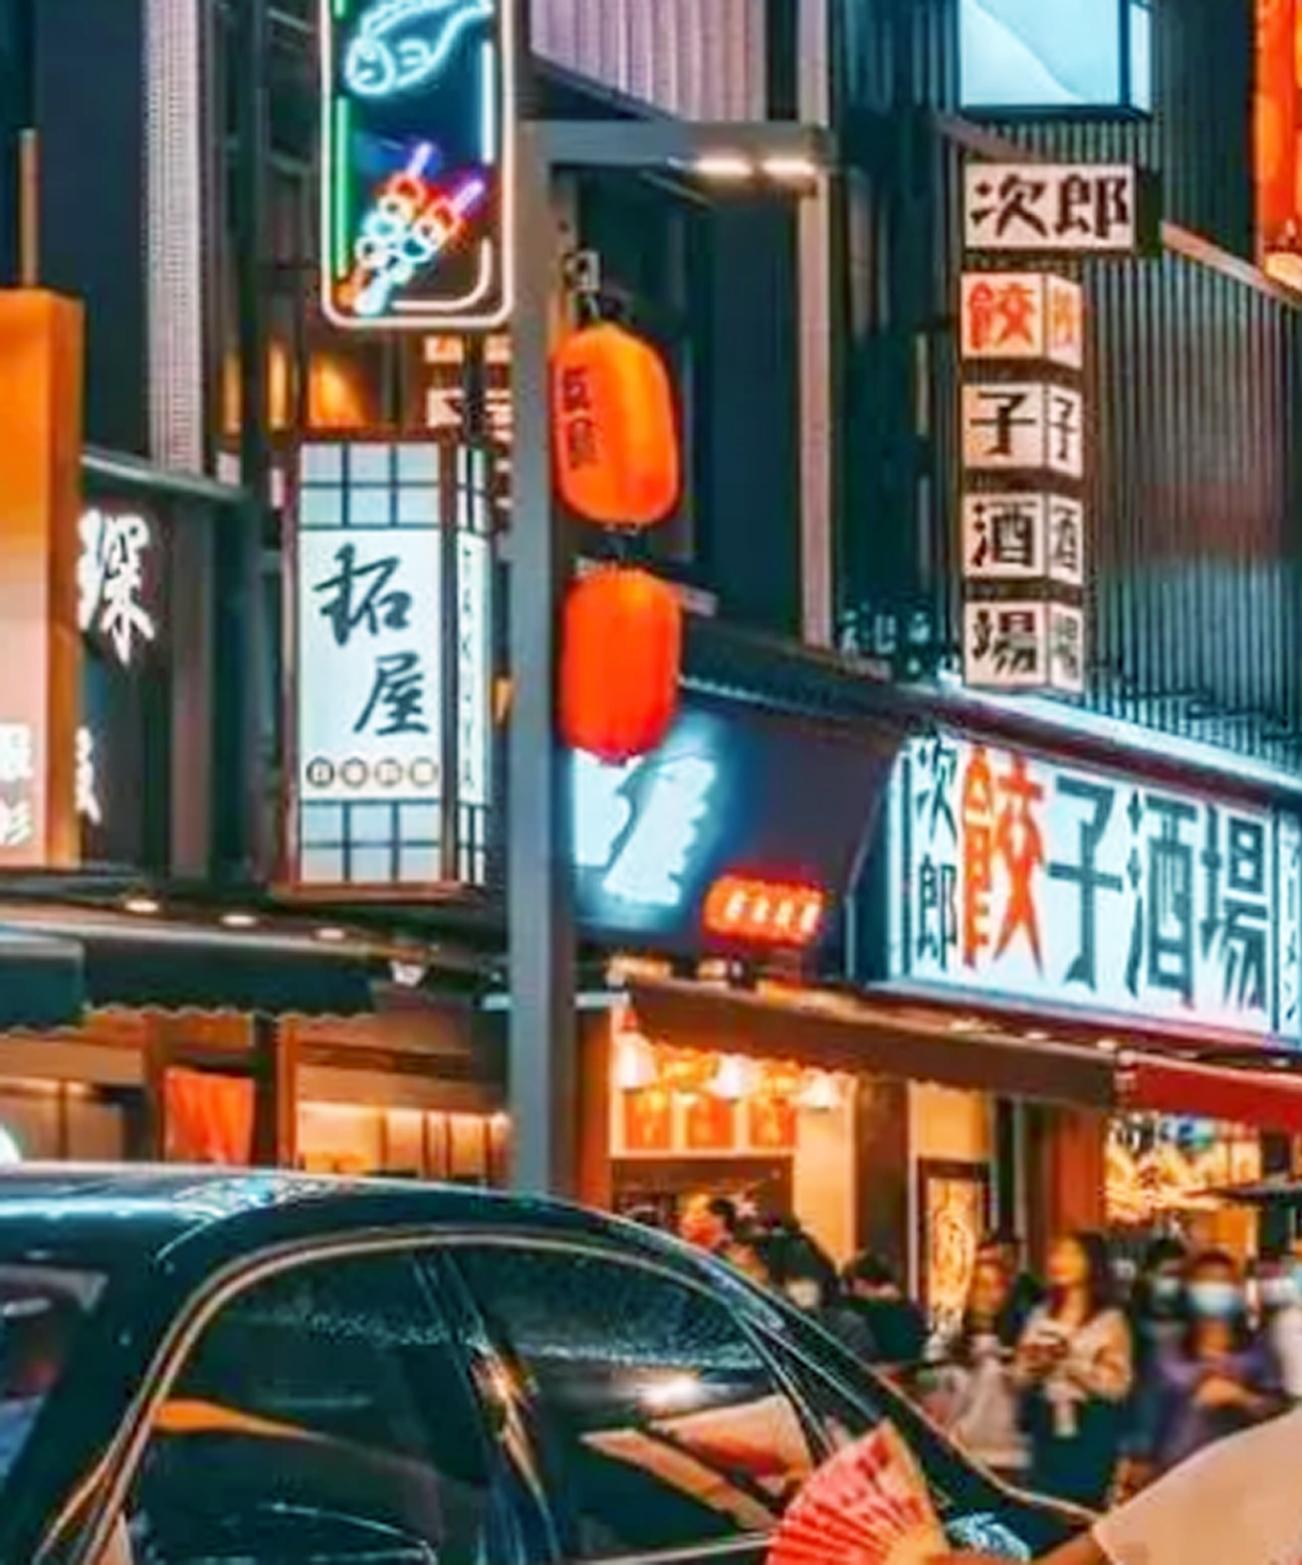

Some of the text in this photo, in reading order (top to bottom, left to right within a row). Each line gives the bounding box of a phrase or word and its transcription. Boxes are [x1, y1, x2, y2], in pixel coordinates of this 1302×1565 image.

[970, 172, 1130, 239] 次郎
[968, 282, 1037, 675] 餃子酒場
[312, 542, 430, 735] 拓屋
[916, 732, 958, 973] 次郎
[962, 744, 1268, 1013] 餃子酒場
